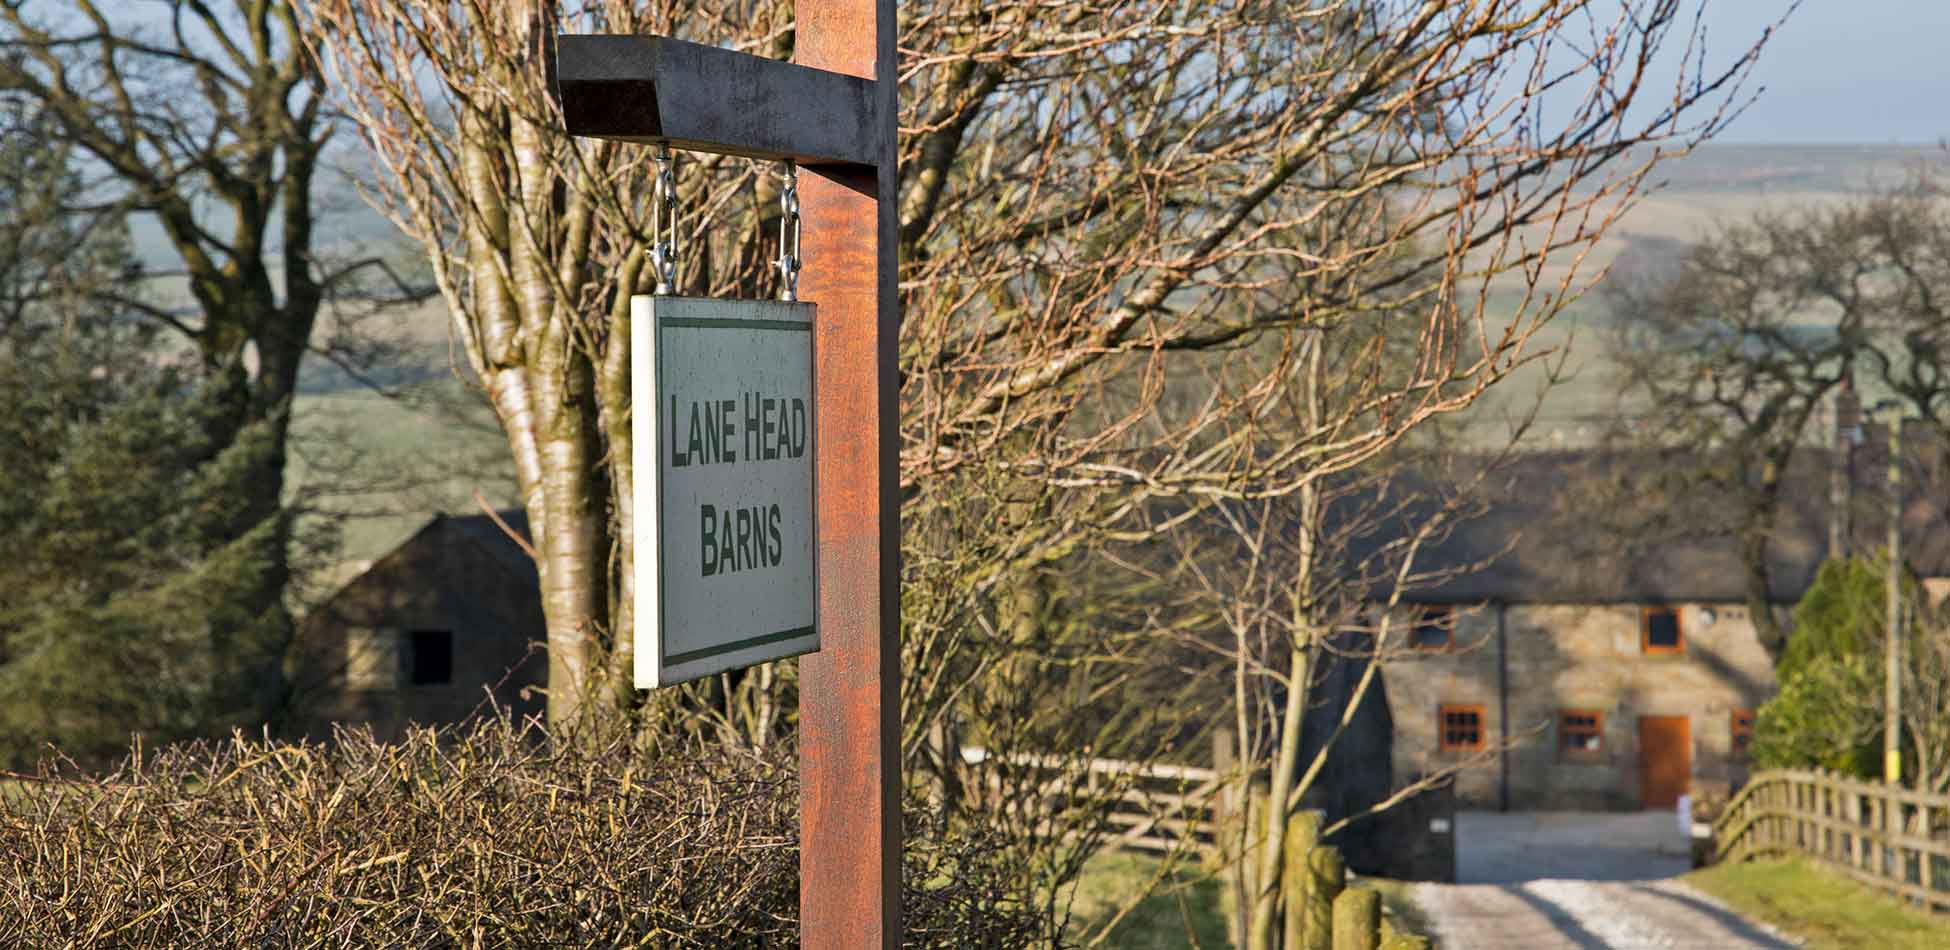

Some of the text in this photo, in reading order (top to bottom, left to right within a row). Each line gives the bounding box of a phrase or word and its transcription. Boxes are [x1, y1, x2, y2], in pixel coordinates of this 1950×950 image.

[671, 391, 806, 467] LANE HEAD
[701, 503, 782, 577] BARNS
